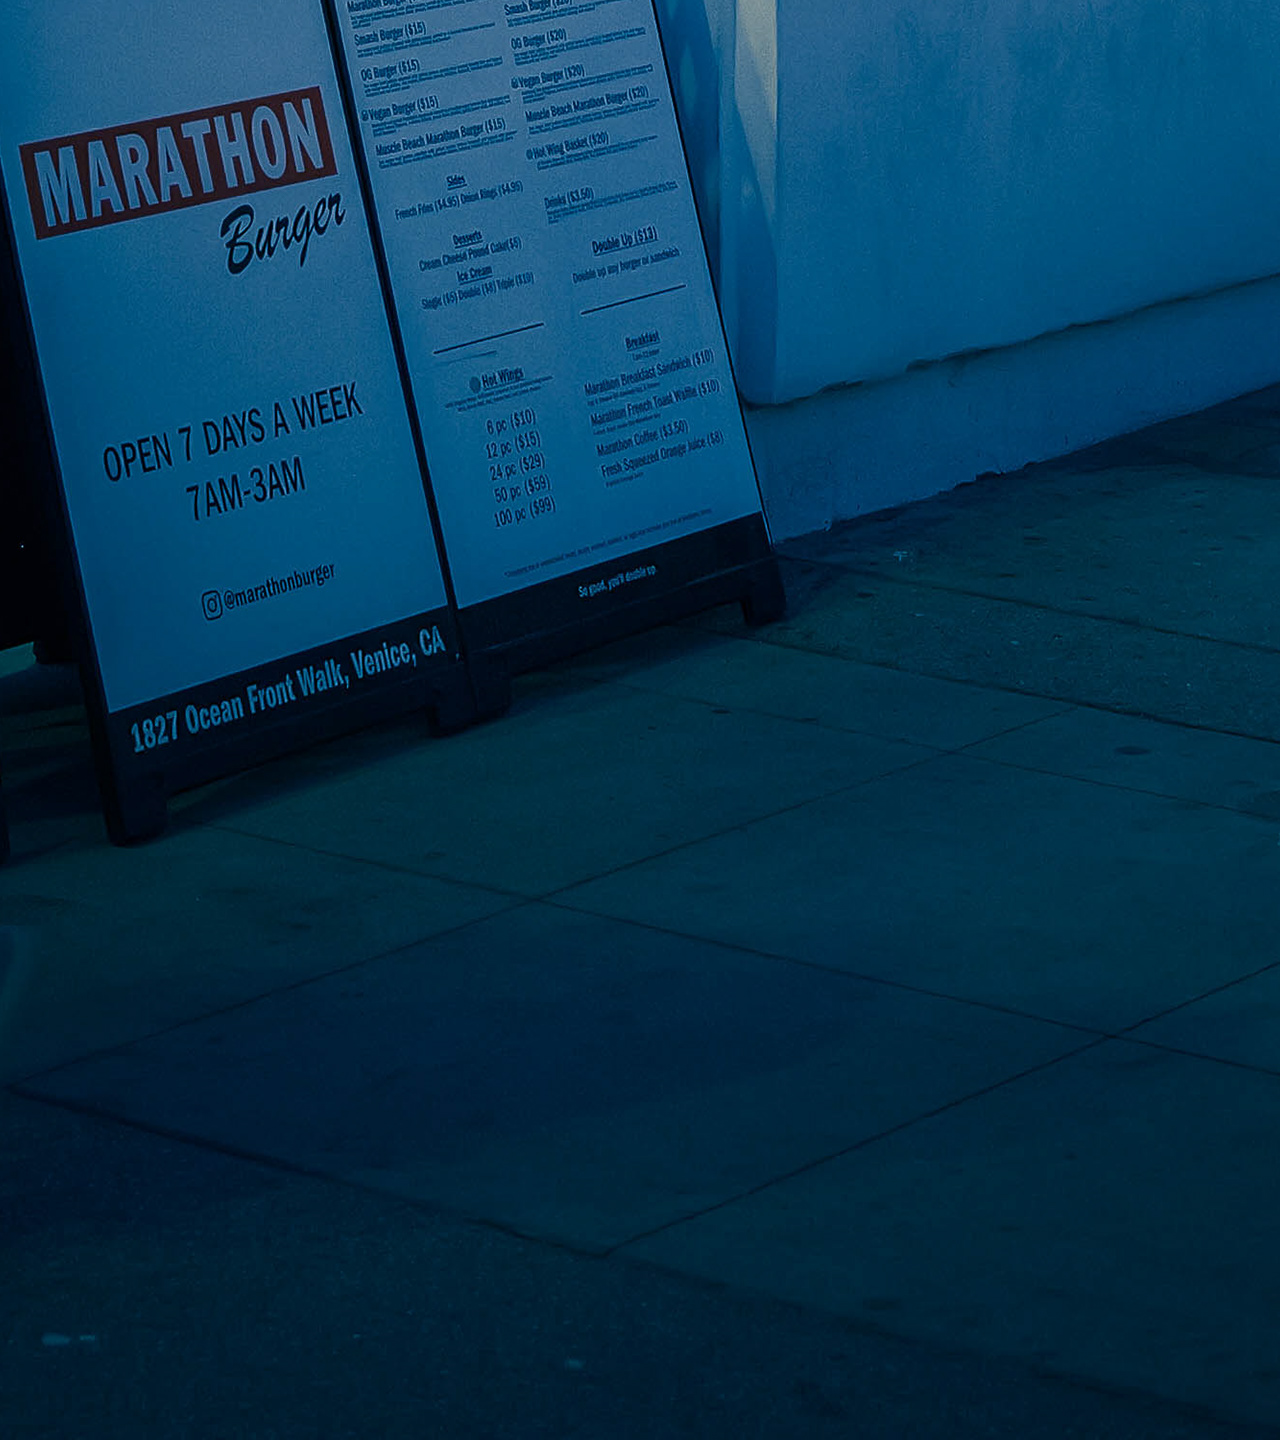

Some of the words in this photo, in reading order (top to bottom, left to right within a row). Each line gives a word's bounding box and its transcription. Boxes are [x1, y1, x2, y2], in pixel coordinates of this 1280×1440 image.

[34, 97, 324, 227] MARATHON
[221, 193, 345, 275] Burger
[103, 434, 172, 483] OPEN
[178, 427, 194, 461] 7
[204, 408, 265, 455] DAYS
[274, 402, 290, 438] A
[293, 382, 363, 430] WEEK
[486, 442, 498, 458] 12
[501, 441, 512, 456] pc
[515, 430, 541, 453] ($15)
[186, 456, 306, 521] 7AM-3AM
[490, 464, 502, 480] 24
[505, 464, 516, 480] pc
[520, 453, 545, 474] ($29)
[495, 487, 507, 503] 50
[510, 486, 521, 501] pc
[525, 474, 551, 495] ($59)
[495, 509, 512, 527] 100
[515, 507, 526, 523] pc
[530, 495, 556, 518] ($99)
[223, 562, 337, 610] @marathonburger
[130, 710, 179, 753] 1827
[185, 693, 244, 735] Ocean
[247, 675, 296, 714] Front
[297, 656, 350, 690] Walk,
[350, 640, 417, 678] Venice,
[419, 624, 447, 656] CA
